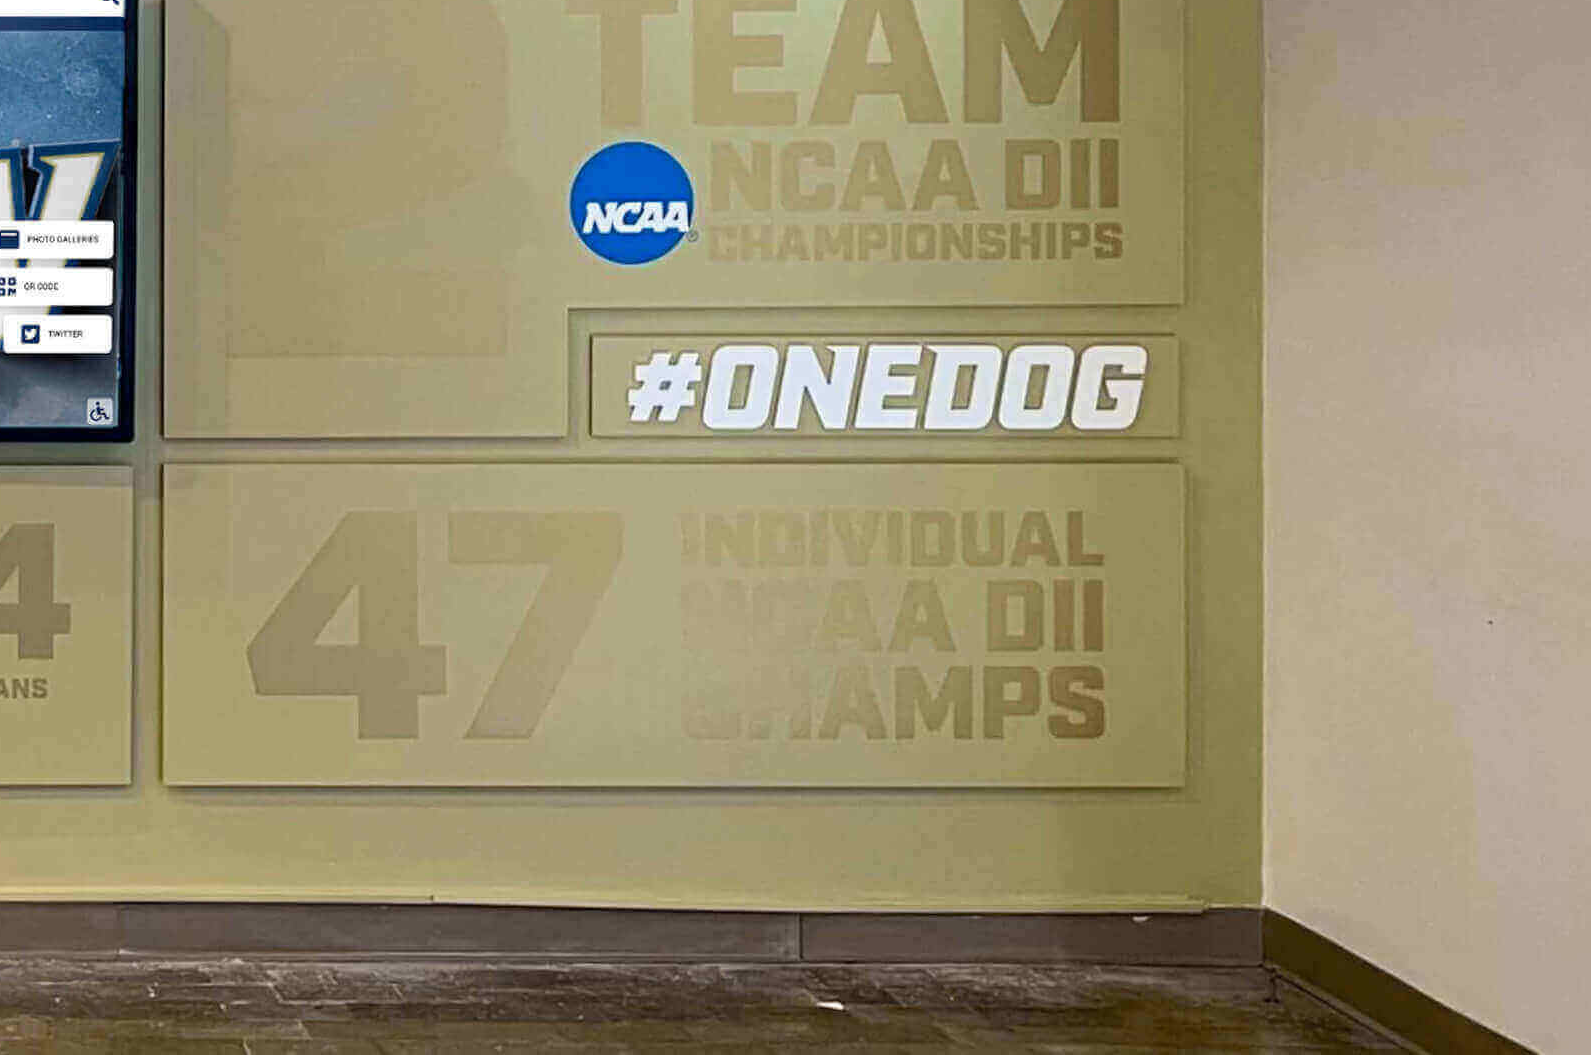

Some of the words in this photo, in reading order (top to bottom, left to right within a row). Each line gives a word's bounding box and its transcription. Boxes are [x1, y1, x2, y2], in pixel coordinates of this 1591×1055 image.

[711, 139, 980, 212] NCAA
[1005, 137, 1121, 212] DII
[583, 201, 690, 234] NCAA
[708, 221, 1125, 263] CHAMPIONSHIPS
[49, 329, 83, 338] TWITTER
[627, 344, 1148, 431] #ONEDOG
[246, 511, 623, 739] 47
[680, 579, 957, 652] AA
[986, 579, 1104, 652] DII
